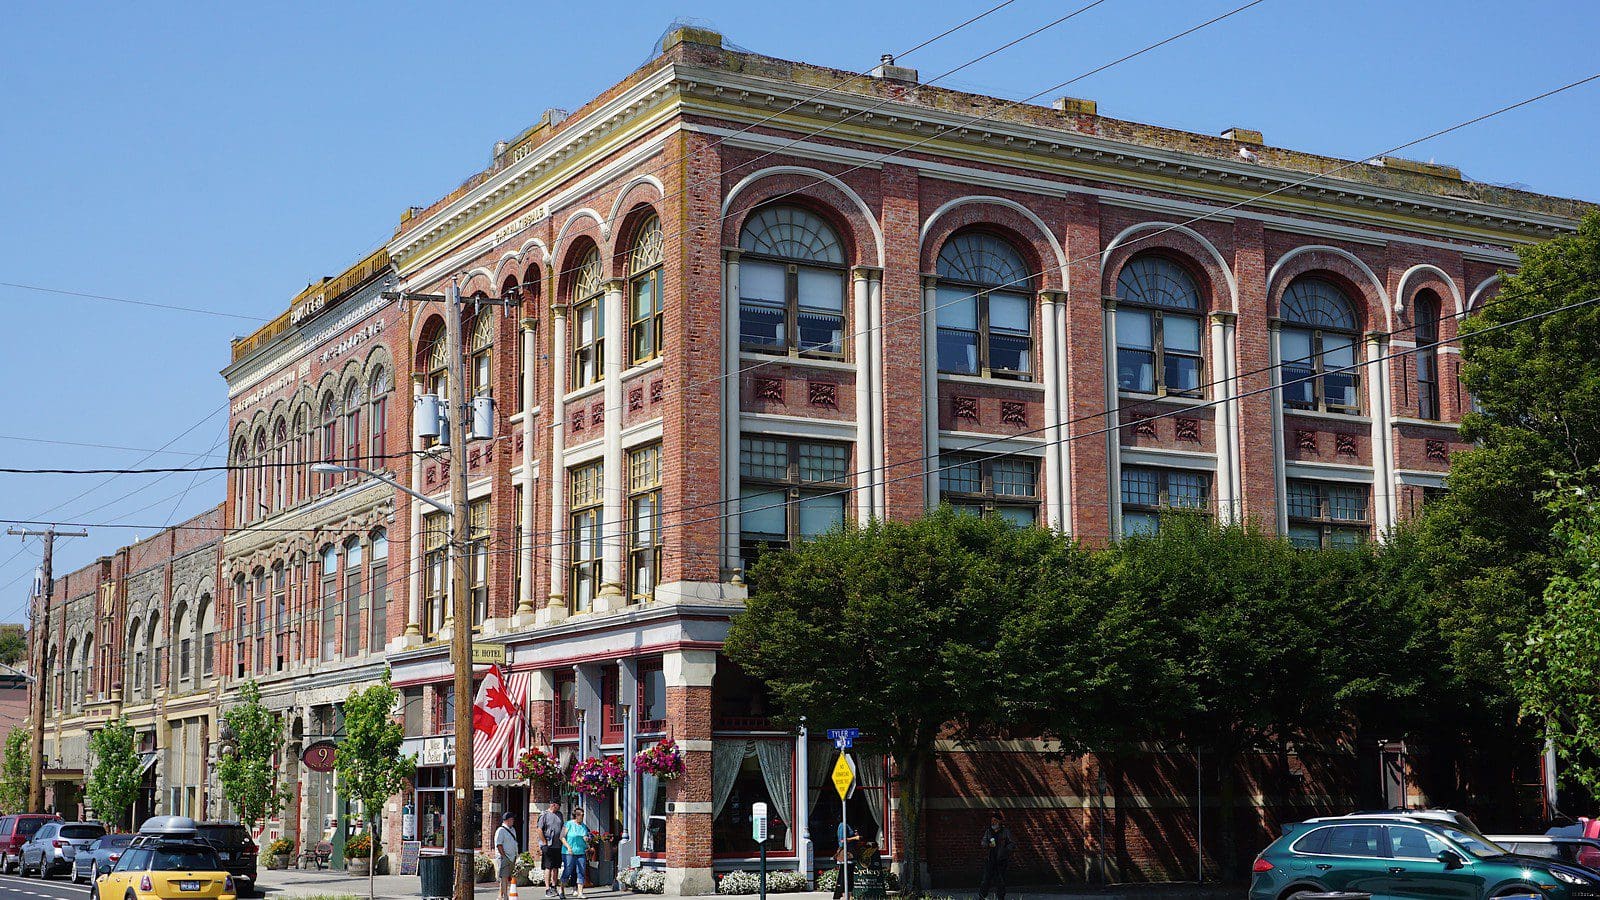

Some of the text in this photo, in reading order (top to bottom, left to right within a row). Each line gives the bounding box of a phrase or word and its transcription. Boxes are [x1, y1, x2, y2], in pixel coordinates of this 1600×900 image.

[481, 649, 502, 658] HOTEL
[831, 730, 849, 738] TYLER
[318, 748, 328, 763] 9
[490, 769, 518, 780] HOTE
